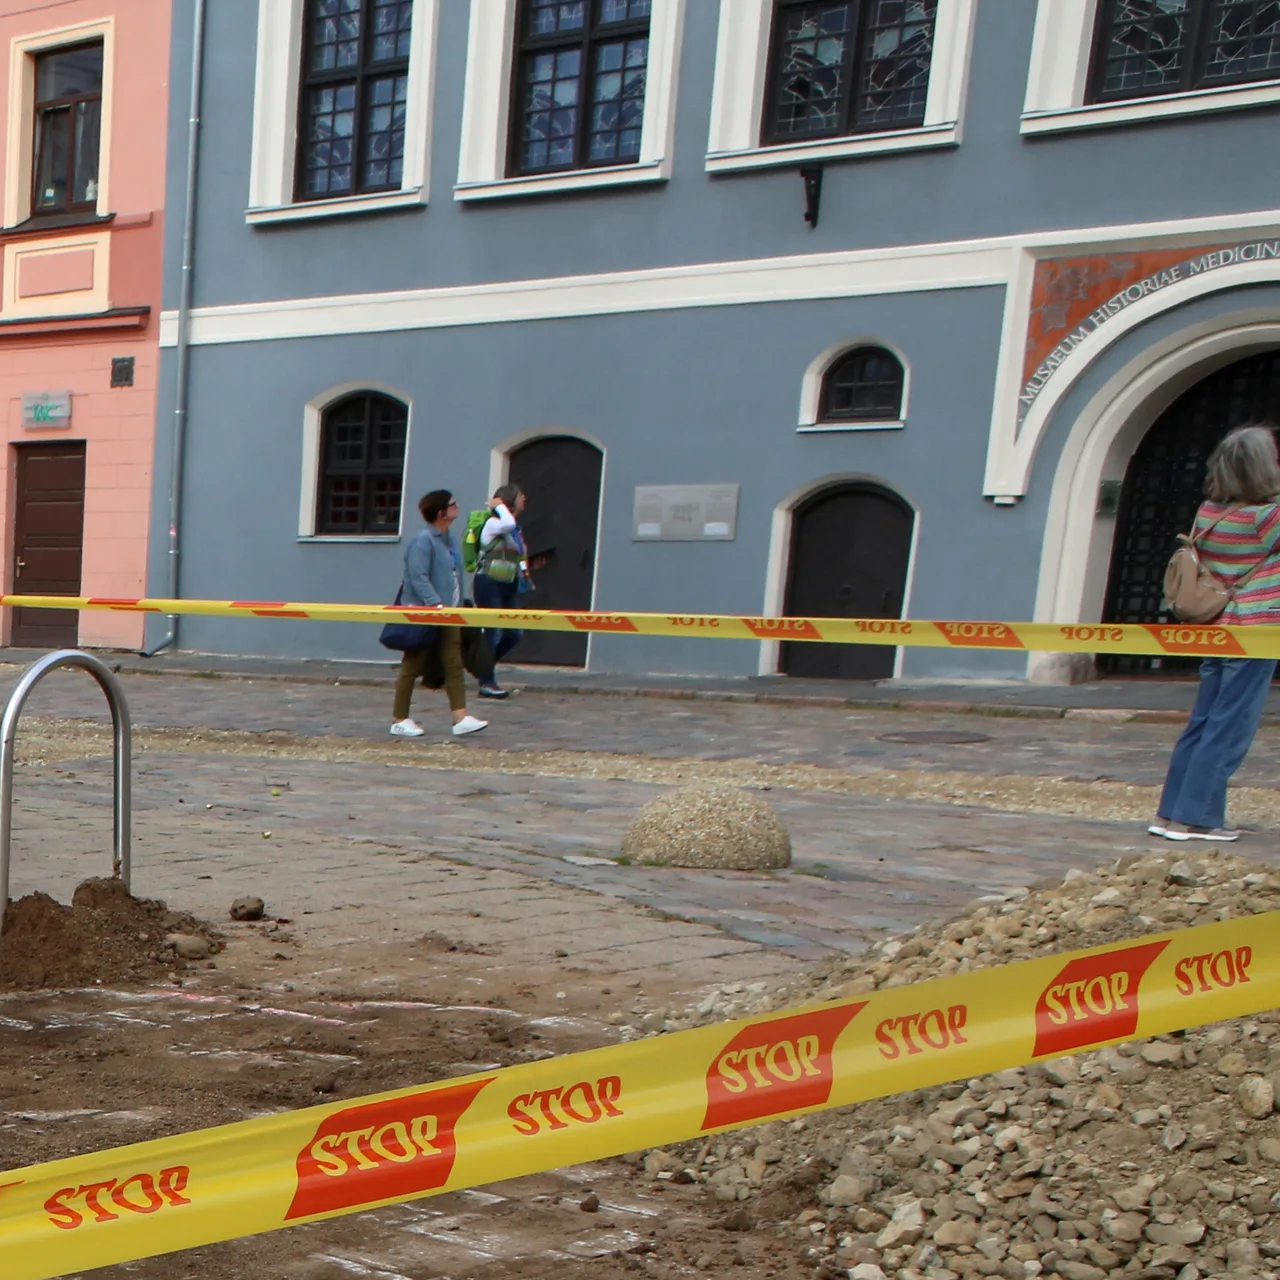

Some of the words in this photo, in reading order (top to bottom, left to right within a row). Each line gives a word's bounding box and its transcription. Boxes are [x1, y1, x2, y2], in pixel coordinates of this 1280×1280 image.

[1019, 326, 1091, 407] MUSAEUM
[1088, 266, 1182, 329] HISTORIAE
[1188, 241, 1280, 276] MEDICIN
[32, 403, 58, 424] WC
[43, 1165, 192, 1230] STOP
[310, 1114, 442, 1177] STOP
[507, 1075, 625, 1136] STOP
[717, 1034, 822, 1094] STOP
[874, 1003, 969, 1060] STOP
[1044, 970, 1130, 1026] STOP
[1174, 945, 1253, 996] STOP
